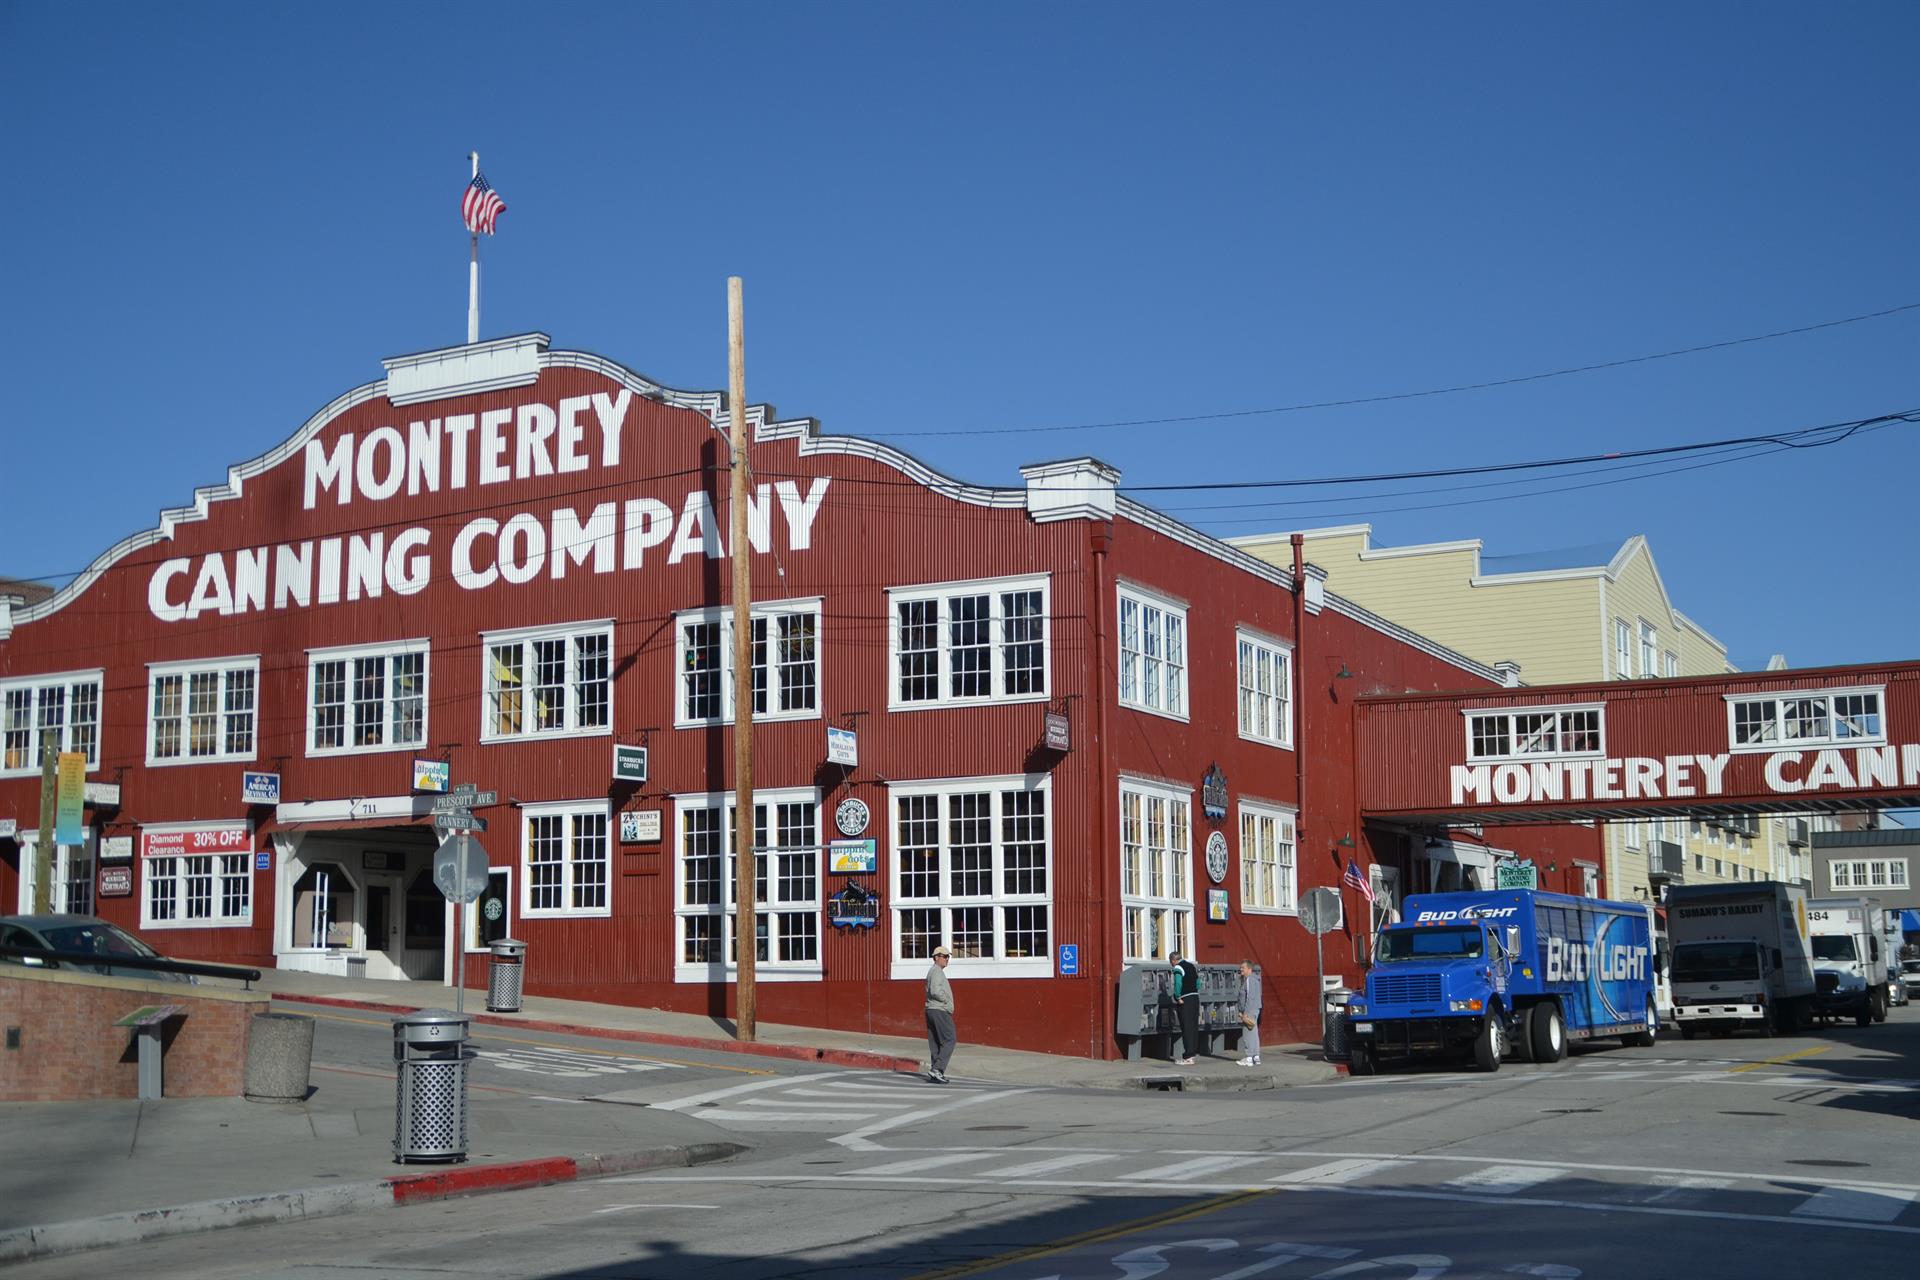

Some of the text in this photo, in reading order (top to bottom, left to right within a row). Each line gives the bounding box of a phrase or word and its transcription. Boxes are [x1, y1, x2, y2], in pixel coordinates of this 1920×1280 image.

[302, 388, 632, 510] MONTEREY
[147, 475, 832, 622] CANNING COMPANY
[618, 756, 644, 765] STARBUCKS
[623, 762, 640, 770] COFFEE
[1450, 753, 1730, 806] MONTEREY
[248, 782, 276, 791] AMERICAN
[246, 790, 267, 798] REVIVAL
[437, 795, 474, 808] PRESCOTT
[838, 800, 867, 816] STARBUCKS
[362, 804, 377, 814] 711
[438, 815, 470, 829] CANNERY
[841, 823, 863, 834] COFFEE
[150, 834, 184, 844] Diamond
[193, 831, 243, 848] 30% OFF
[148, 845, 186, 856] Clearance
[1418, 907, 1518, 921] BUD LIGHT
[1727, 903, 1764, 915] BAKERY
[1546, 937, 1647, 982] BUD LIGHT
[1111, 1238, 1583, 1280] ST
